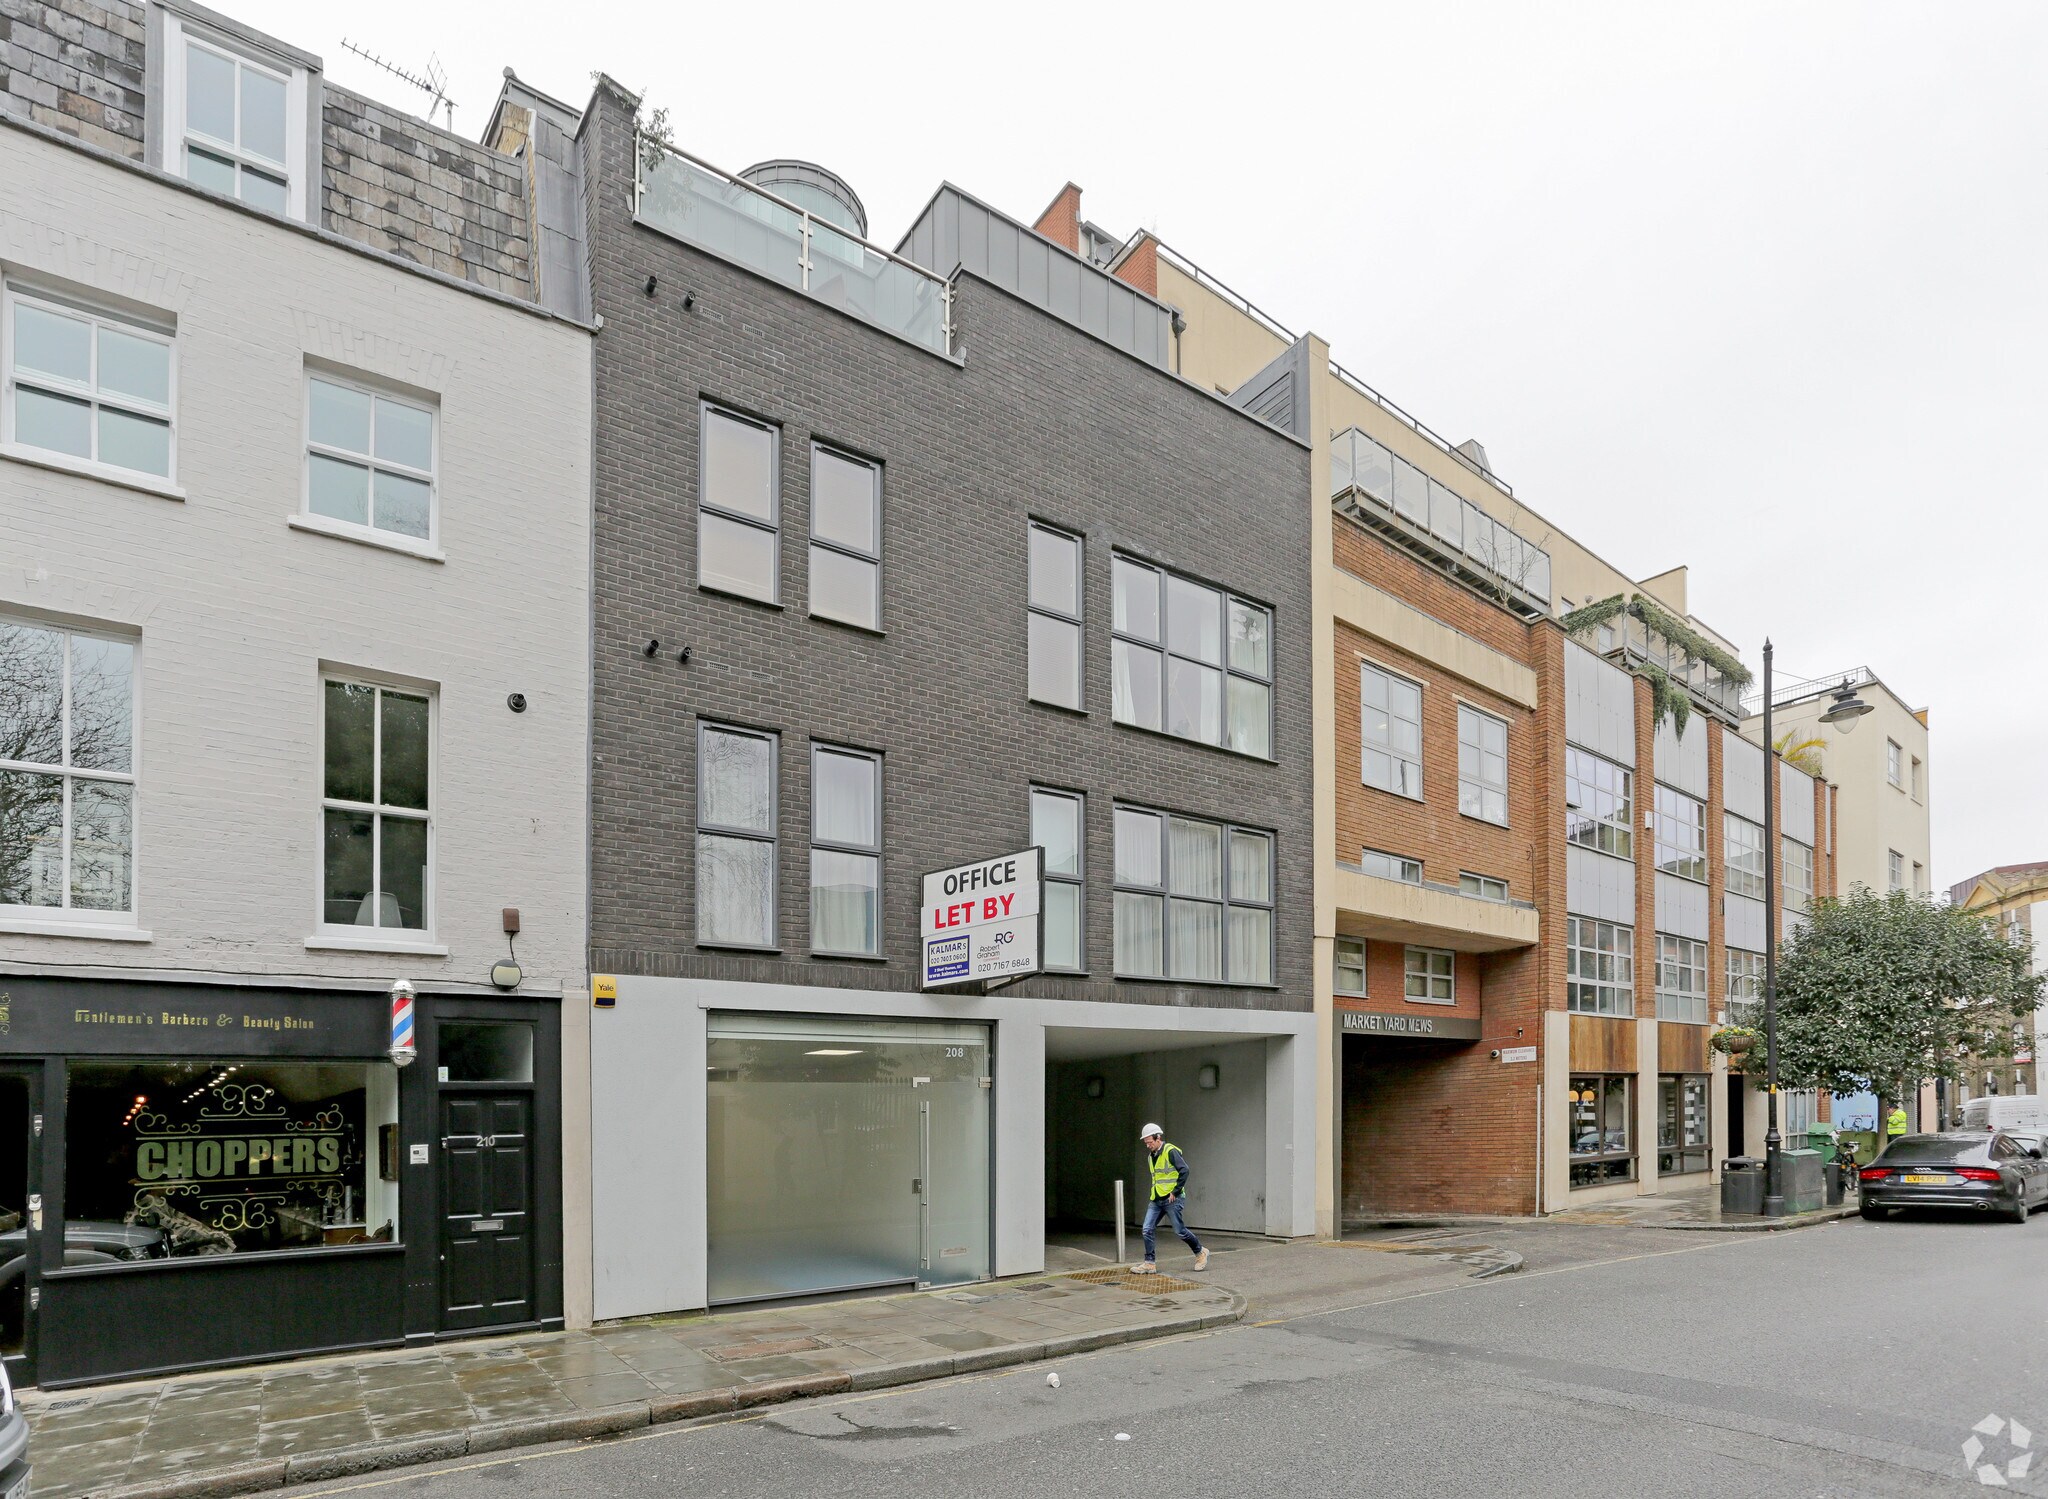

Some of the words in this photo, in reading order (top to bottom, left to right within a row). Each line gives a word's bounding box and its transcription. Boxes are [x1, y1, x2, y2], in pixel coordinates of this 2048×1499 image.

[943, 860, 1016, 896] OFFICE
[935, 901, 975, 930] LET
[983, 892, 1015, 920] BY
[977, 951, 1000, 959] Graham
[980, 944, 1000, 953] Robert
[931, 956, 940, 965] 020
[940, 954, 952, 963] 7403
[953, 952, 967, 960] 0600
[978, 963, 991, 973] 020
[993, 961, 1010, 971] 7167
[1011, 958, 1030, 968] 6848
[929, 968, 969, 979] www.kalmars.com
[598, 983, 614, 992] Yale
[161, 1011, 209, 1026] Barbers
[216, 1013, 233, 1027] &
[243, 1015, 281, 1031] Beauty
[283, 1016, 314, 1029] Salon
[1343, 1013, 1381, 1030] MARKET
[1383, 1016, 1406, 1031] YARD
[1408, 1018, 1433, 1033] MEWS
[945, 1047, 964, 1058] 208
[476, 1136, 496, 1147] 210
[136, 1136, 340, 1181] CHOPPERS
